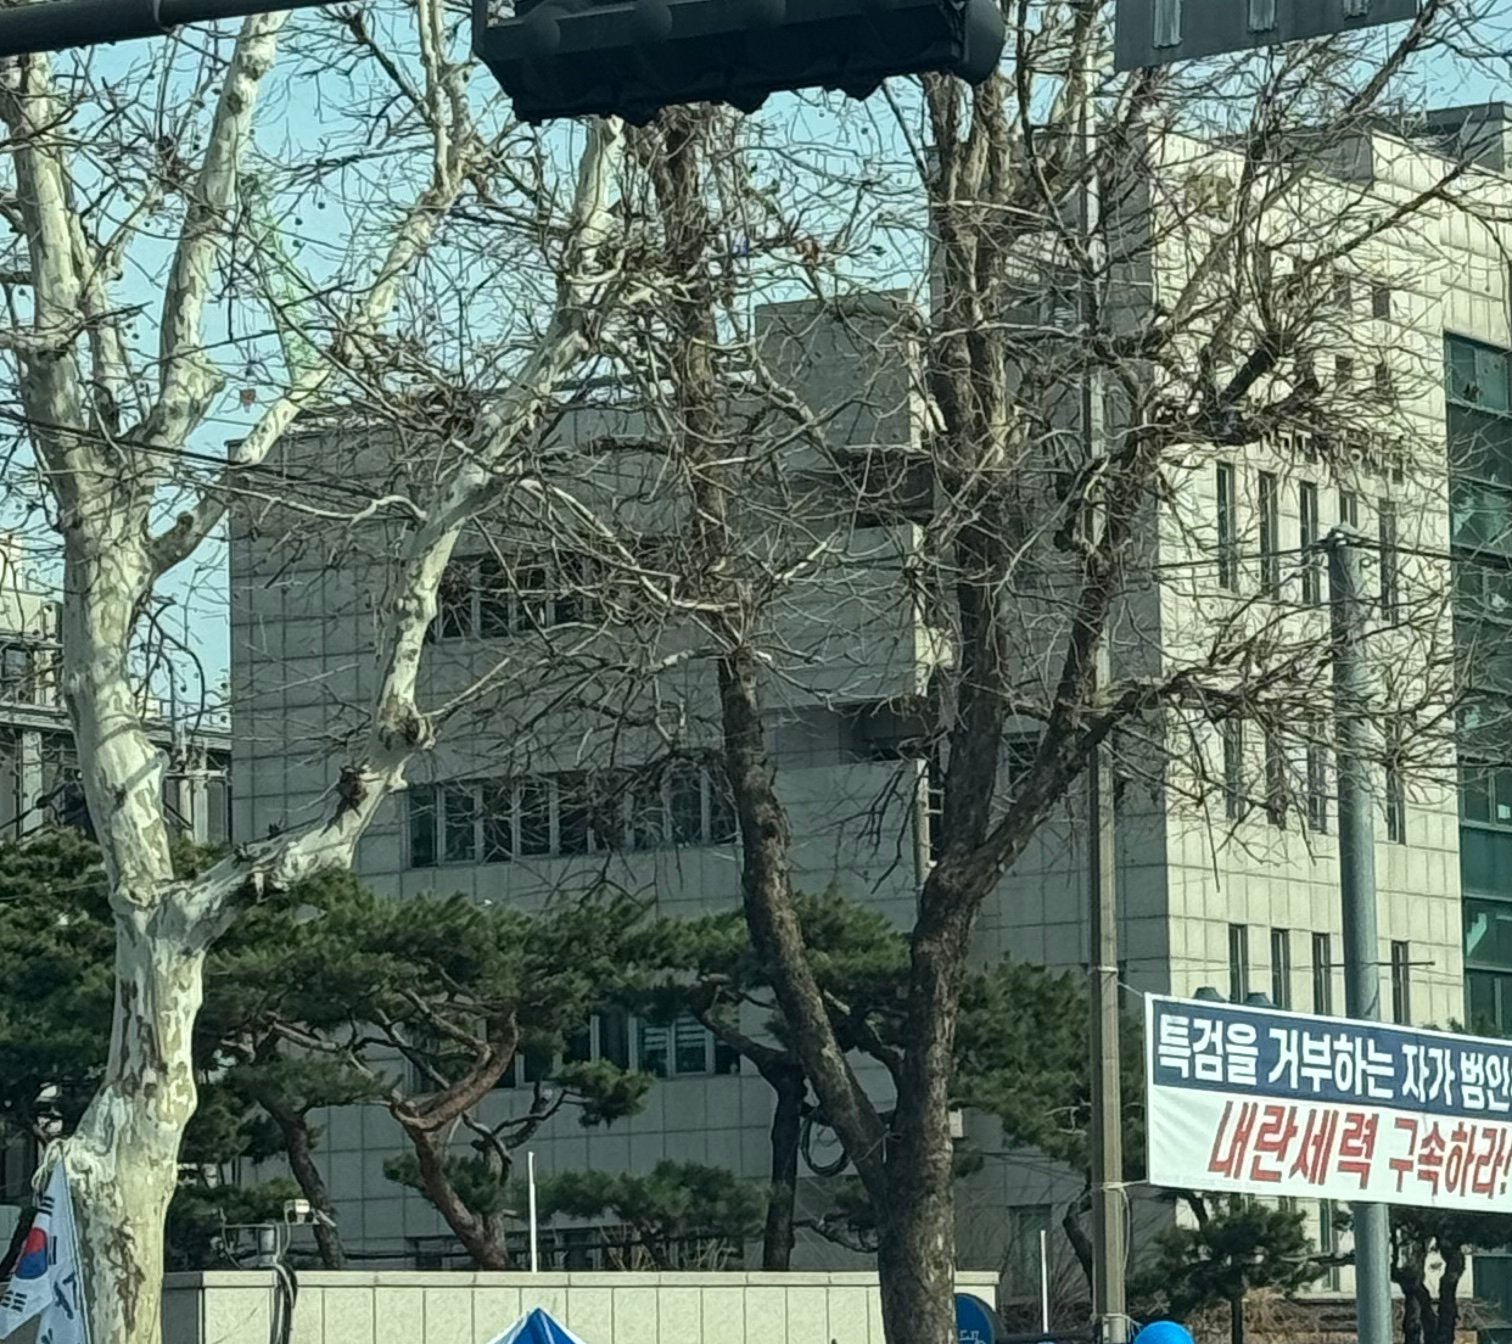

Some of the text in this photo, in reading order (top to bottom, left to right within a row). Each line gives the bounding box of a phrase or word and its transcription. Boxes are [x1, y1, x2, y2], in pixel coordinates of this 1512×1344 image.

[1158, 1013, 1258, 1086] 특검을
[1267, 1027, 1395, 1099] 거부하는
[1401, 1042, 1456, 1104] 자가
[1207, 1100, 1378, 1190] 내란세력
